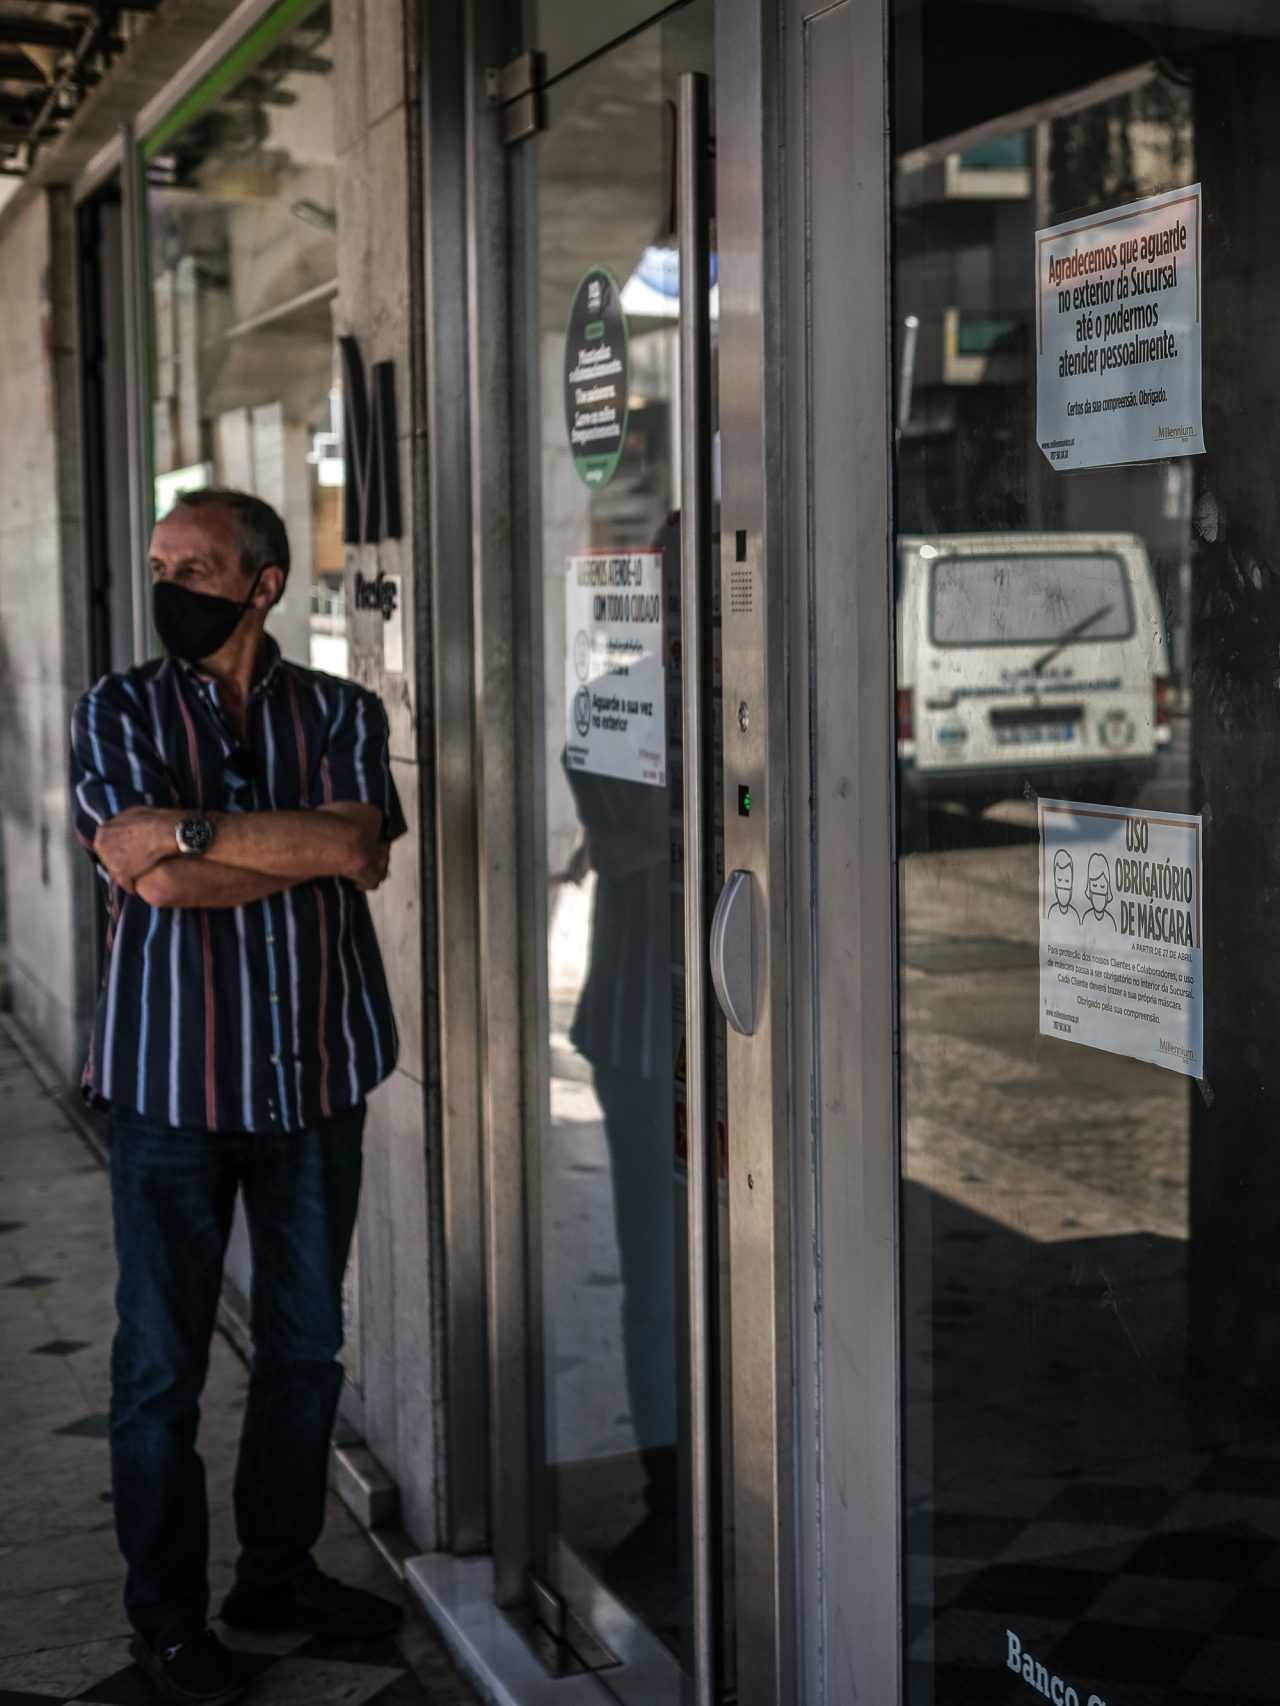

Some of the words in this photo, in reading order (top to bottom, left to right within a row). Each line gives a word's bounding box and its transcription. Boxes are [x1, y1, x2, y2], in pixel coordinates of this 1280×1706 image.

[1049, 245, 1117, 286] Agradecemos
[1120, 239, 1138, 269] que
[1141, 220, 1186, 263] aguarde
[1059, 289, 1070, 313] no
[1073, 275, 1114, 309] exterior
[1117, 270, 1128, 300] da
[1131, 256, 1177, 296] Sucursal
[1076, 311, 1093, 342] até
[1096, 316, 1102, 338] o
[1104, 303, 1158, 341] podermos
[1059, 345, 1098, 378] atender
[1100, 330, 1177, 375] pessoalmente.
[1067, 401, 1084, 416] Certos
[1085, 399, 1091, 414] da
[1092, 401, 1101, 413] sua
[1103, 392, 1138, 412] compreensão.
[1139, 387, 1167, 406] Obrigado.
[1159, 426, 1193, 438] Millennium
[593, 694, 619, 713] Aguarde
[627, 700, 638, 714] sua
[641, 702, 652, 716] vez
[593, 715, 600, 728] no
[1126, 816, 1148, 854] USO
[1115, 857, 1192, 903] OBRIGATÓRIO
[1121, 900, 1135, 936] DE
[1138, 898, 1193, 947] MÁSCARA
[1048, 945, 1058, 954] Para
[1059, 948, 1080, 959] proteção
[1082, 952, 1091, 962] dos
[1092, 956, 1109, 965] nossos
[1110, 958, 1131, 970] Clientes
[1137, 964, 1177, 982] Colaboradores,
[1184, 976, 1194, 984] uso
[1136, 944, 1153, 954] PARTIR
[1155, 947, 1161, 956] DE
[1163, 949, 1168, 958] 27
[1170, 951, 1176, 959] DE
[1178, 951, 1192, 962] ABRIL
[1048, 958, 1053, 966] de
[1055, 960, 1074, 971] máscara
[1075, 965, 1089, 975] passa
[1104, 971, 1132, 984] obrigatório
[1141, 978, 1160, 991] interior
[1161, 982, 1168, 993] da
[1170, 985, 1194, 999] Sucursal.
[1058, 974, 1070, 984] Cada
[1071, 977, 1088, 988] Cliente
[1089, 982, 1106, 992] deverá
[1108, 986, 1122, 996] trazer
[1128, 991, 1136, 999] sua
[1138, 993, 1157, 1005] própria
[1158, 997, 1182, 1010] máscara.
[1077, 996, 1101, 1009] Obrigado
[1102, 1002, 1112, 1012] pela
[1114, 1006, 1122, 1014] sua
[1124, 1009, 1160, 1024] compreensão.
[1160, 1038, 1193, 1058] Millennium
[1006, 1628, 1078, 1706] Banco
